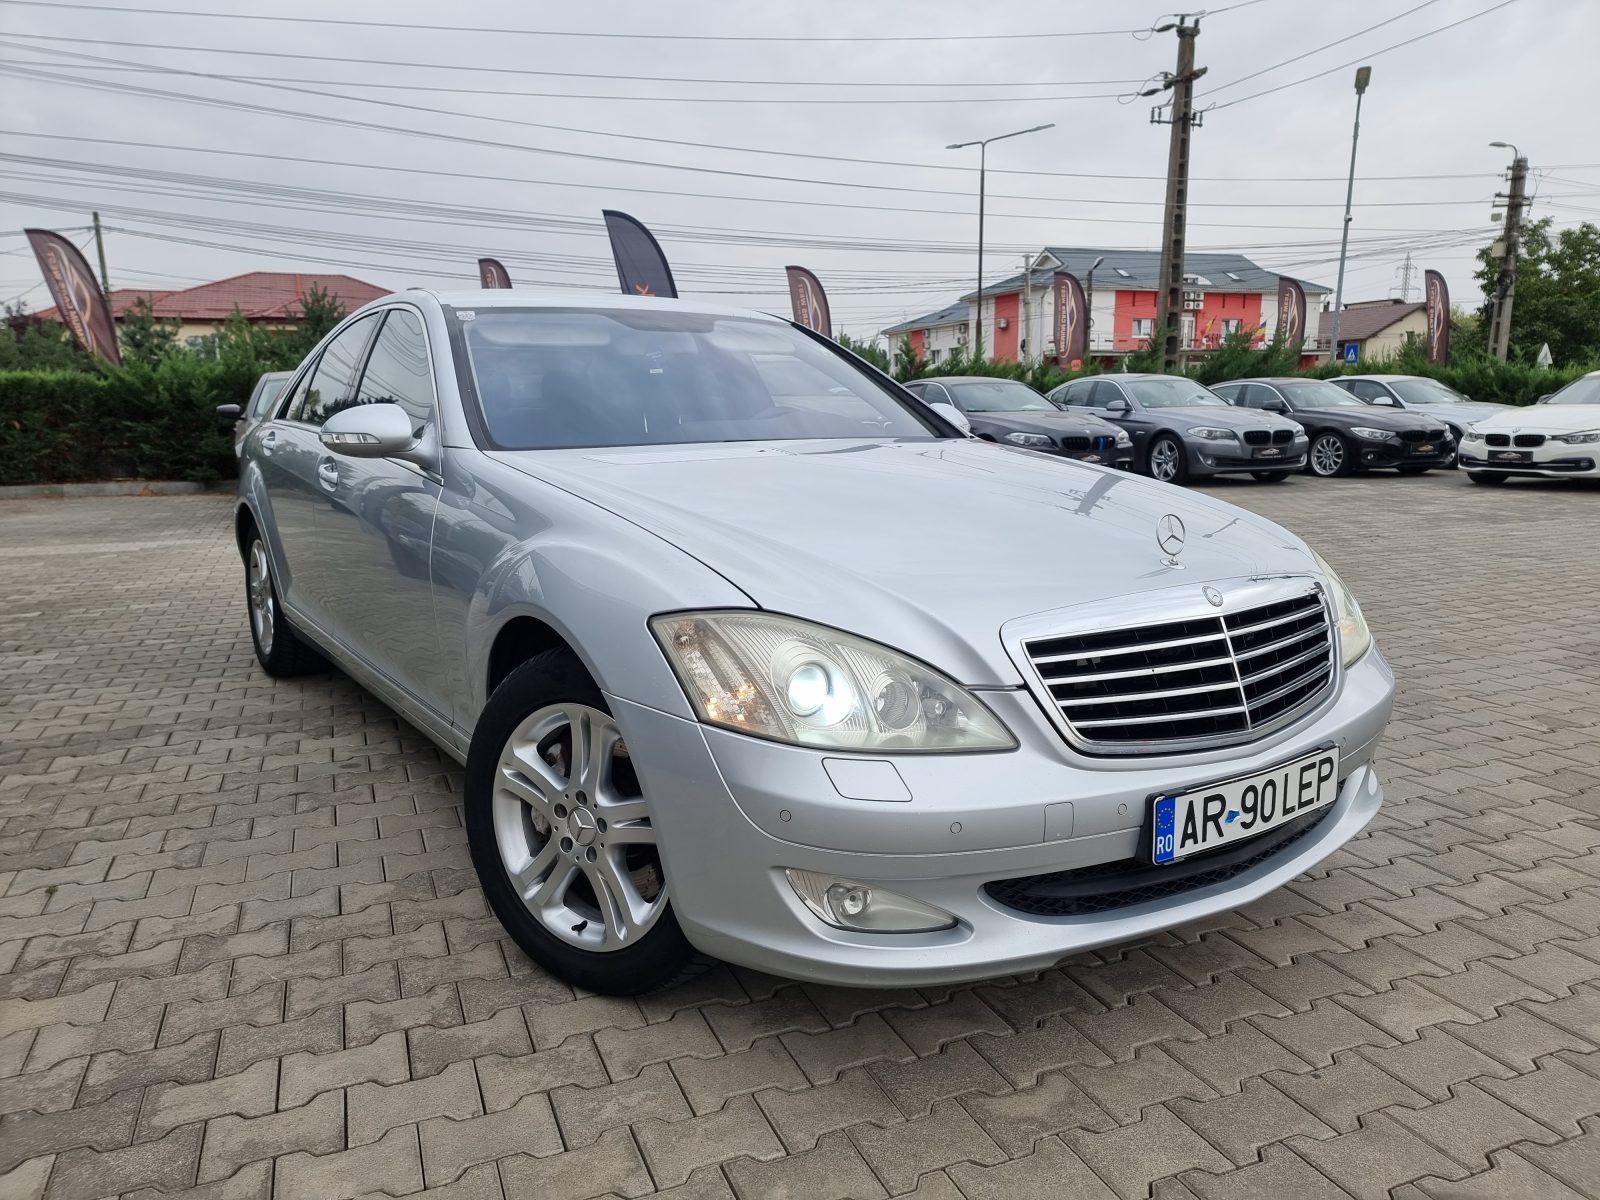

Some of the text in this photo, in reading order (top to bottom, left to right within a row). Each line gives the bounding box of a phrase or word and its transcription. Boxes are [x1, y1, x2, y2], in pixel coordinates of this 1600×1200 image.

[1180, 756, 1335, 849] AR 90 LEP
[1156, 834, 1173, 855] RO
